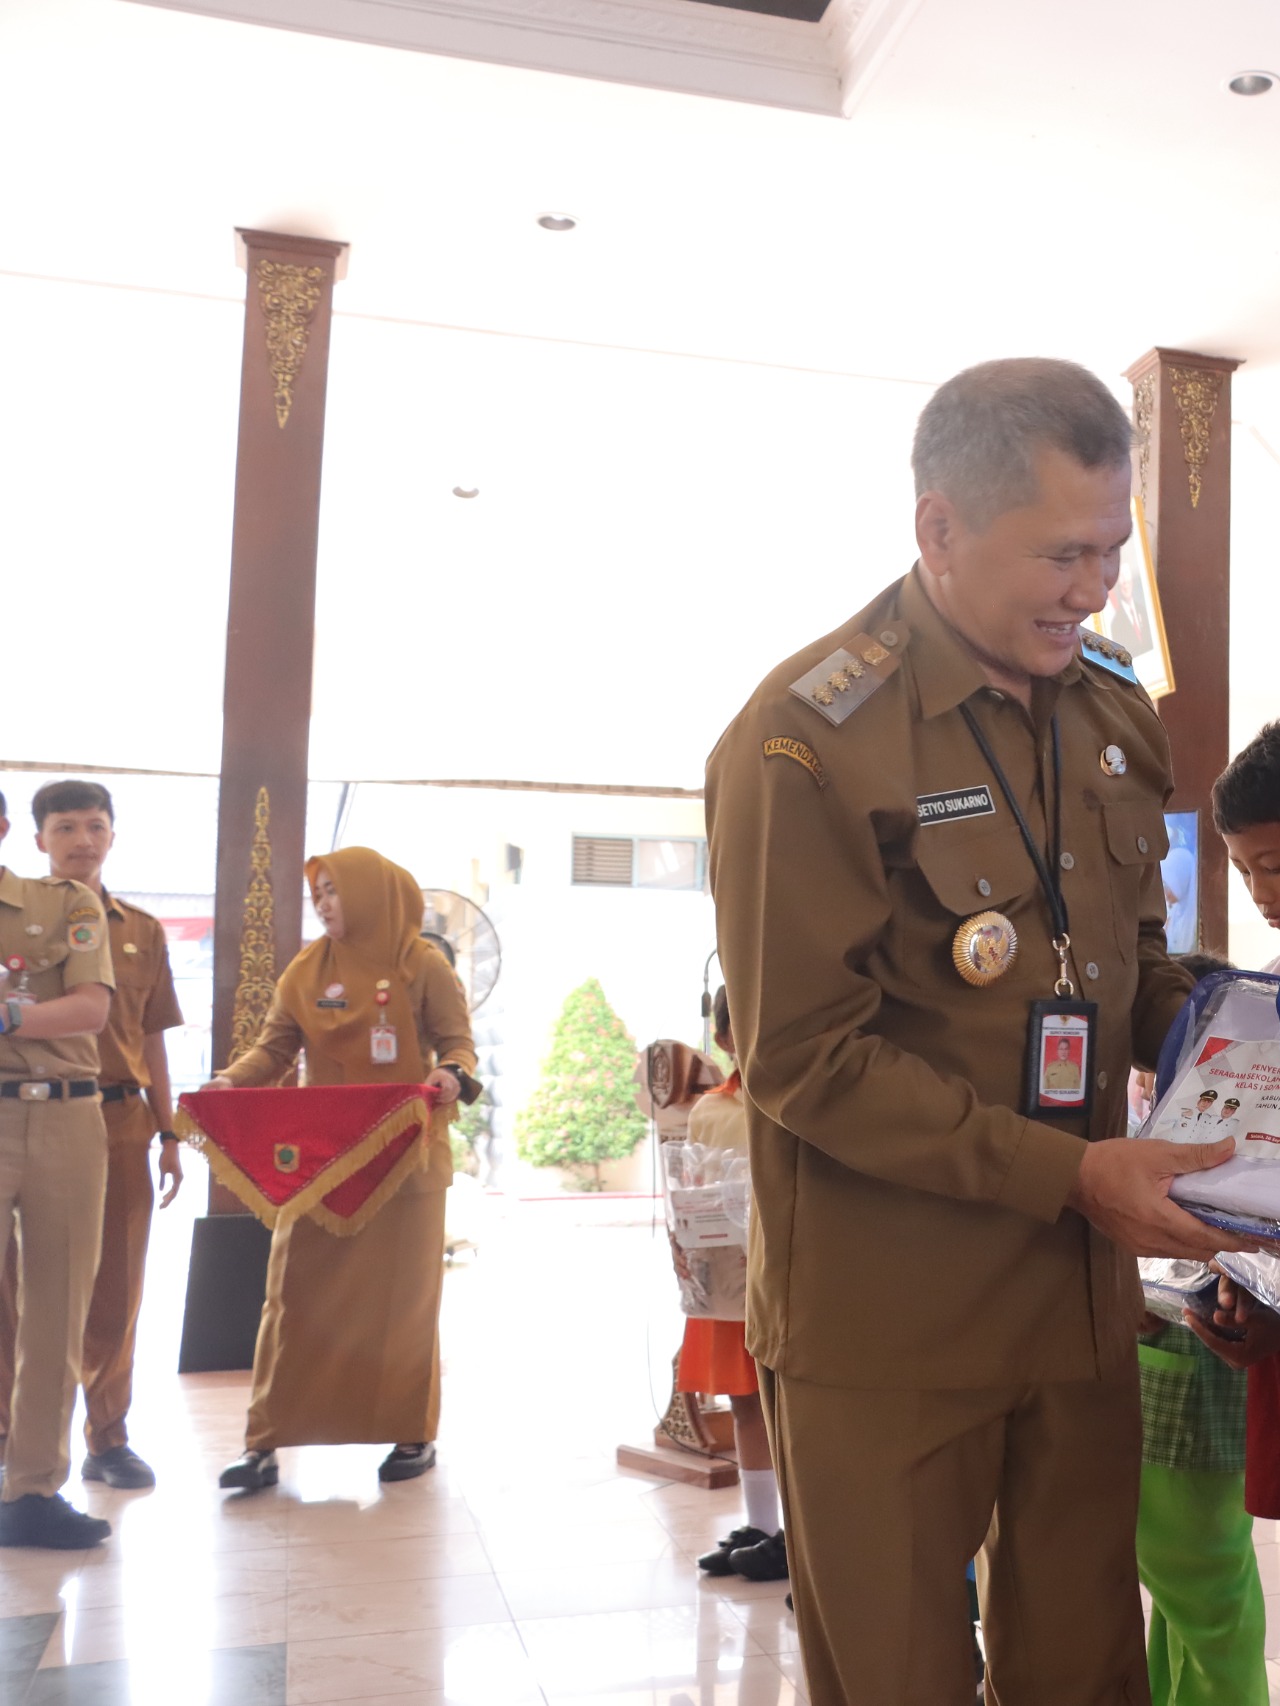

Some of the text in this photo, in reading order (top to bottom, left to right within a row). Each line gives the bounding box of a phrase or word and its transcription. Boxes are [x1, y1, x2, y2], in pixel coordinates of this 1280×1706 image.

[917, 794, 989, 817] SETYO SUKARNO
[1209, 1068, 1246, 1080] SERAGAM
[1247, 1073, 1280, 1083] SEKOLAH
[1235, 1082, 1258, 1090] KELAS
